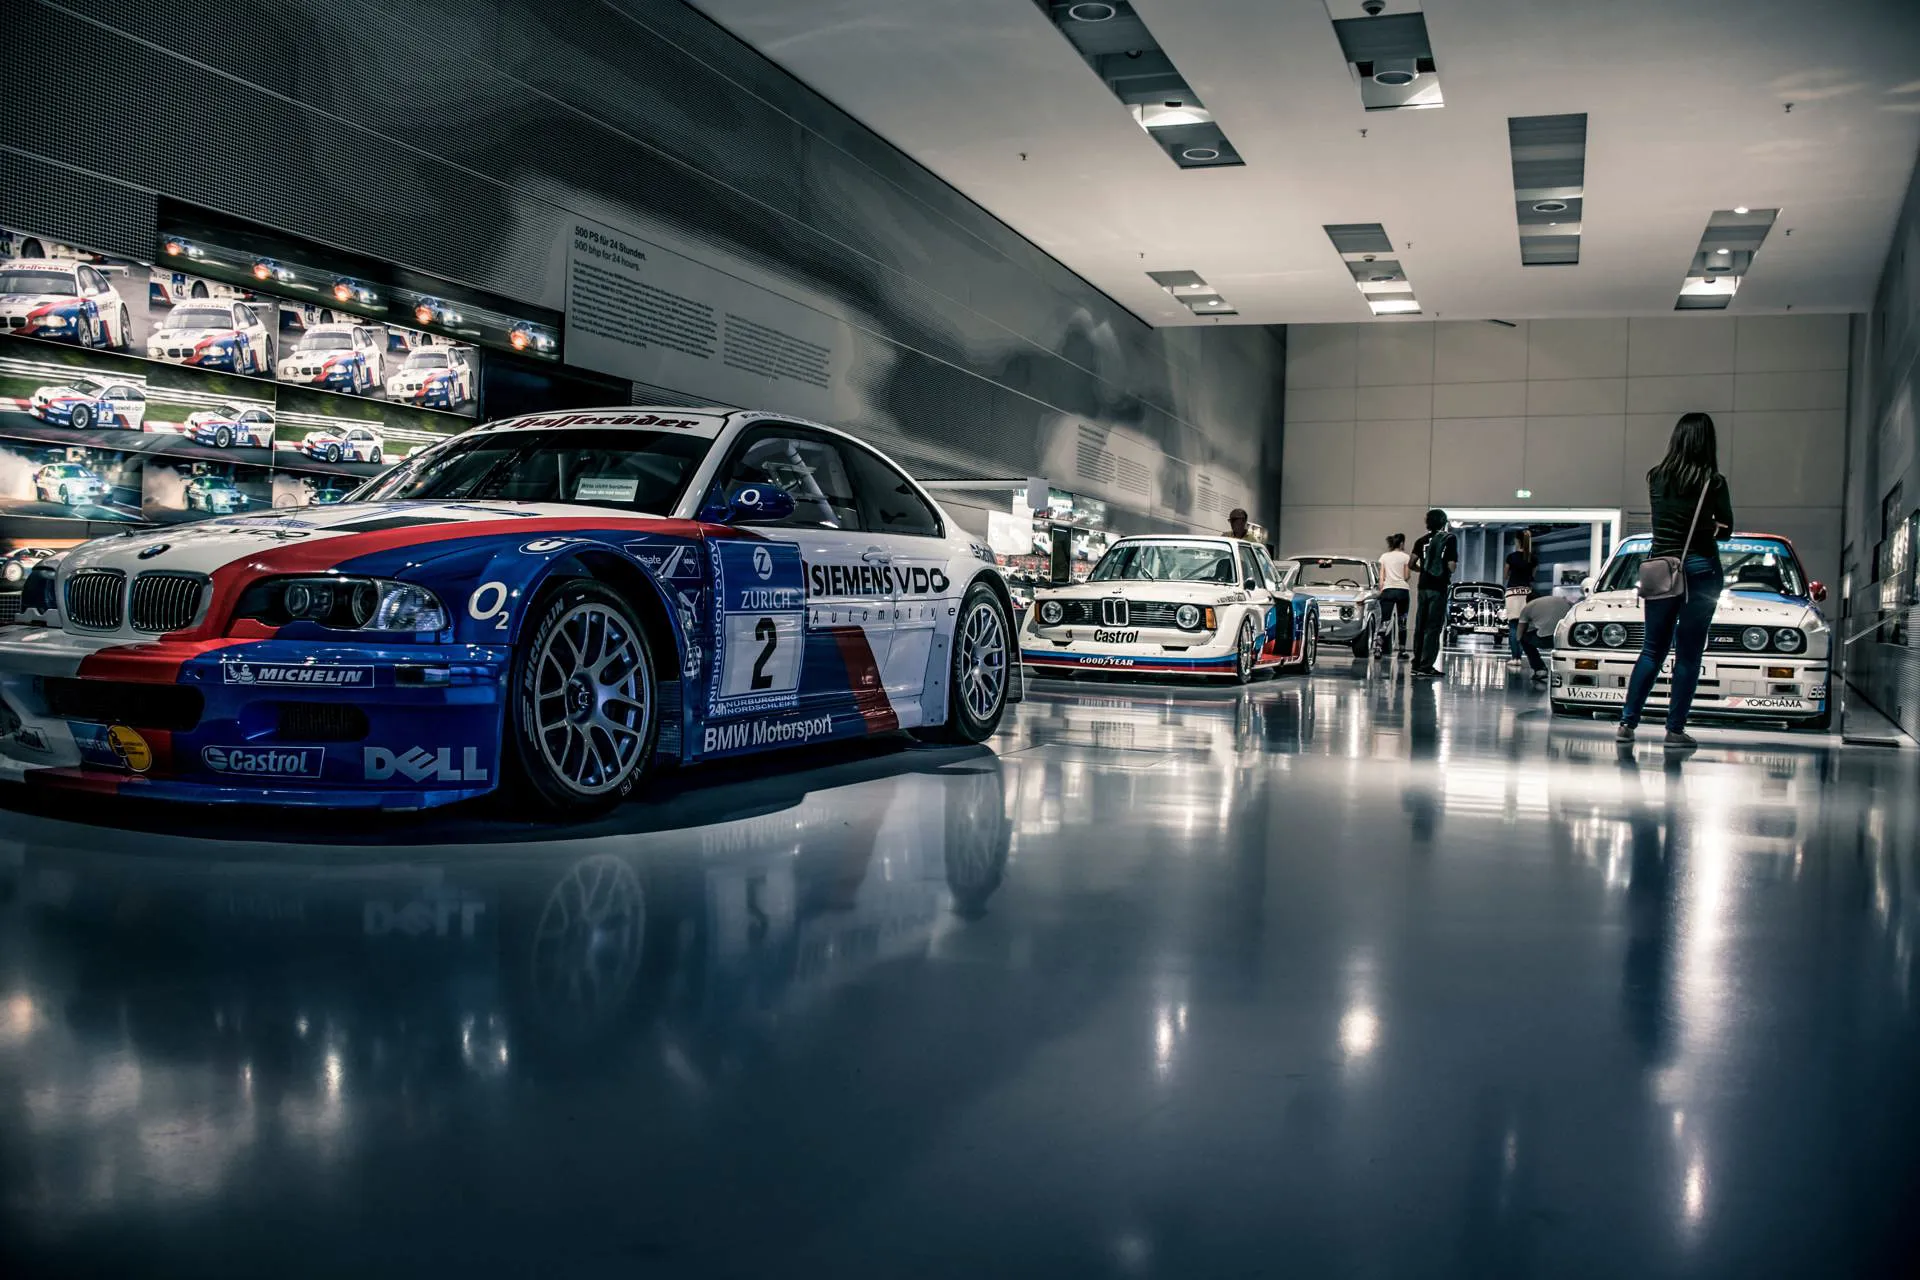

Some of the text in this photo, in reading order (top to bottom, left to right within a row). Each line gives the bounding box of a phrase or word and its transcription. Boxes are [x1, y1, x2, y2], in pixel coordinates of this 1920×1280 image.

[575, 226, 588, 238] 500
[589, 231, 599, 243] PS
[600, 235, 609, 246] für
[609, 240, 618, 250] 24
[574, 239, 588, 252] 500
[588, 244, 601, 257] bhp
[602, 249, 611, 260] for
[612, 253, 620, 263] 24
[1627, 543, 1779, 554] BM orsport
[811, 565, 950, 596] SIEMENS VDO
[741, 590, 791, 609] ZURICH
[707, 541, 723, 702] ADAC NORDRHEIN
[524, 597, 565, 692] MICHELIN
[1094, 629, 1139, 643] Castrol
[751, 617, 777, 690] 2
[258, 667, 363, 683] MICHELIN
[1567, 688, 1625, 700] WARSTEIN
[1745, 699, 1803, 709] YOKOHAMA
[727, 701, 798, 714] NORDSCHLEIFE
[704, 713, 833, 752] BMW Motorsport
[229, 750, 308, 773] Castrol
[364, 745, 488, 783] DELL
